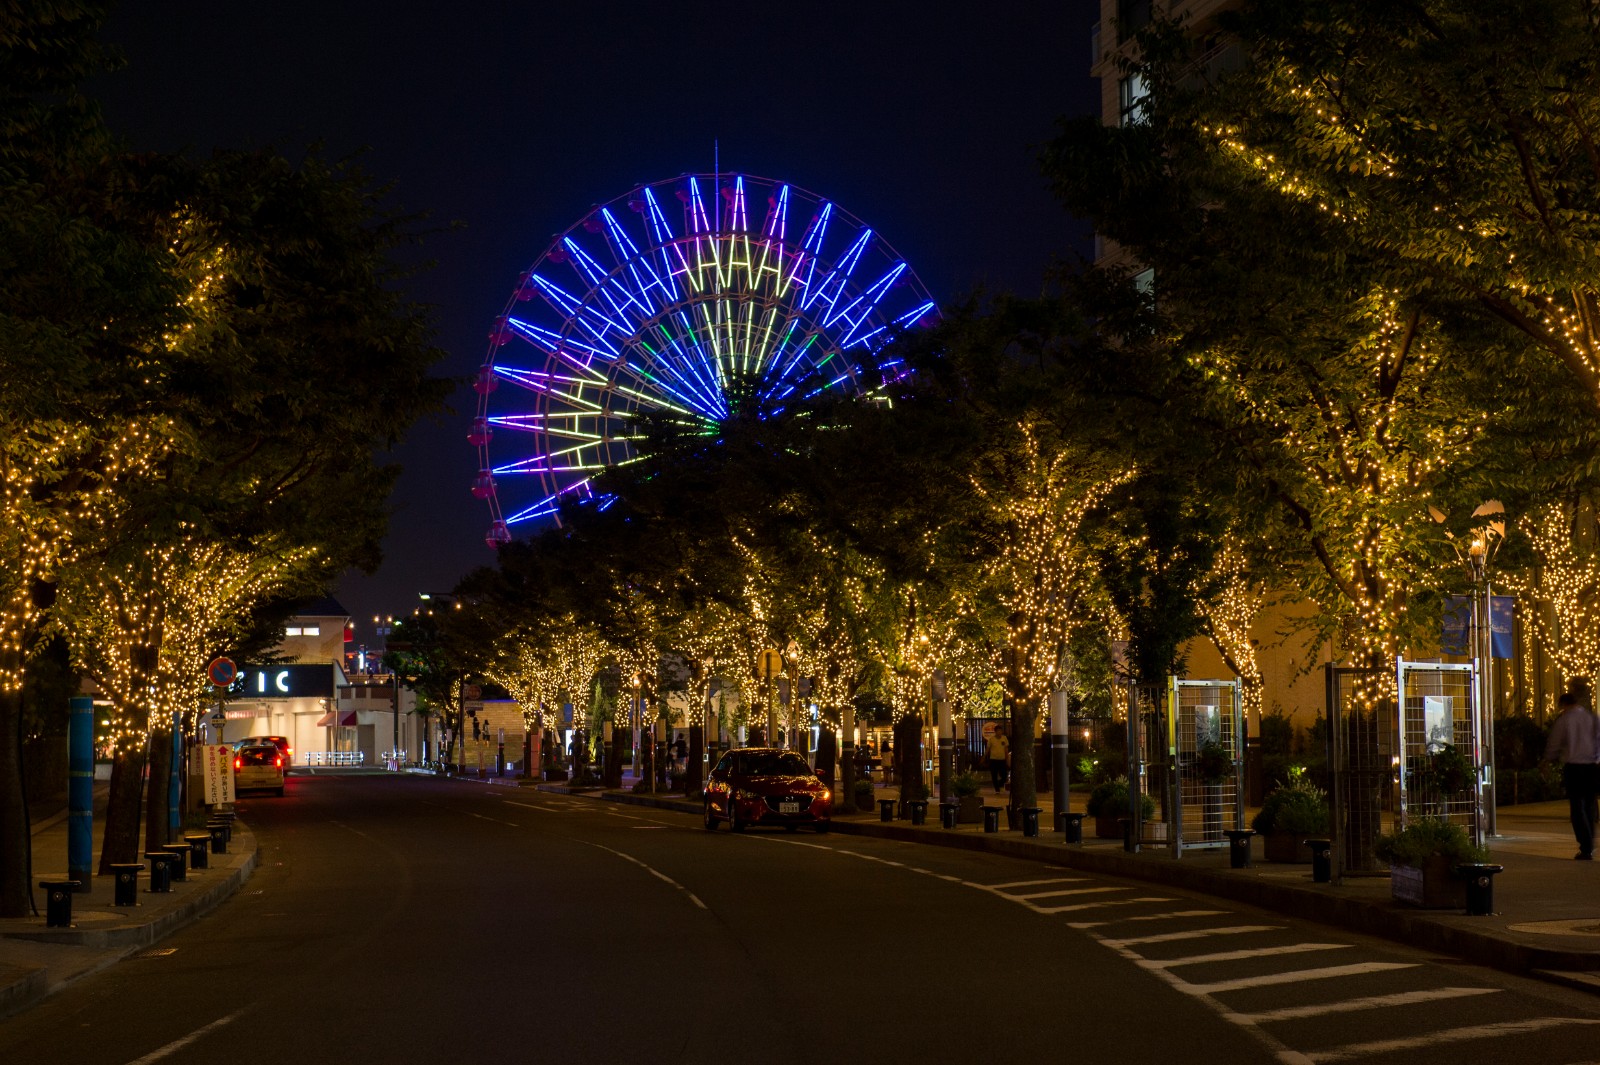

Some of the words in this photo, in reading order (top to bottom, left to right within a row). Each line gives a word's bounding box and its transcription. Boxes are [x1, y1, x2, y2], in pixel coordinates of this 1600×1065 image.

[220, 756, 228, 802] バス停があります
